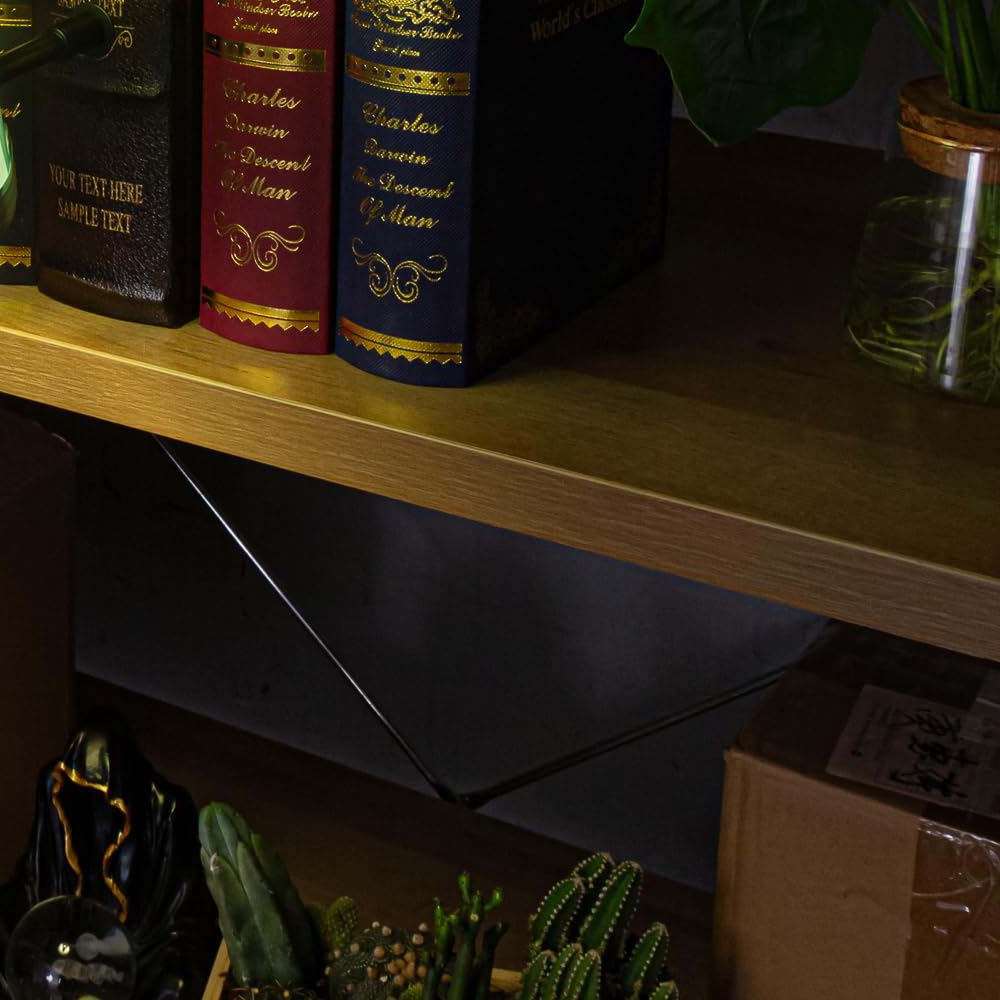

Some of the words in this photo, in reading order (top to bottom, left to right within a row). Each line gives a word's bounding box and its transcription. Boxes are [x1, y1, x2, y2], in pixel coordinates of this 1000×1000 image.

[362, 101, 445, 135] Charles
[49, 163, 77, 190] YOUR
[77, 172, 108, 199] TEXT
[109, 179, 144, 205] HERE
[57, 197, 100, 228] SAMPLE
[99, 208, 133, 234] TEXT
